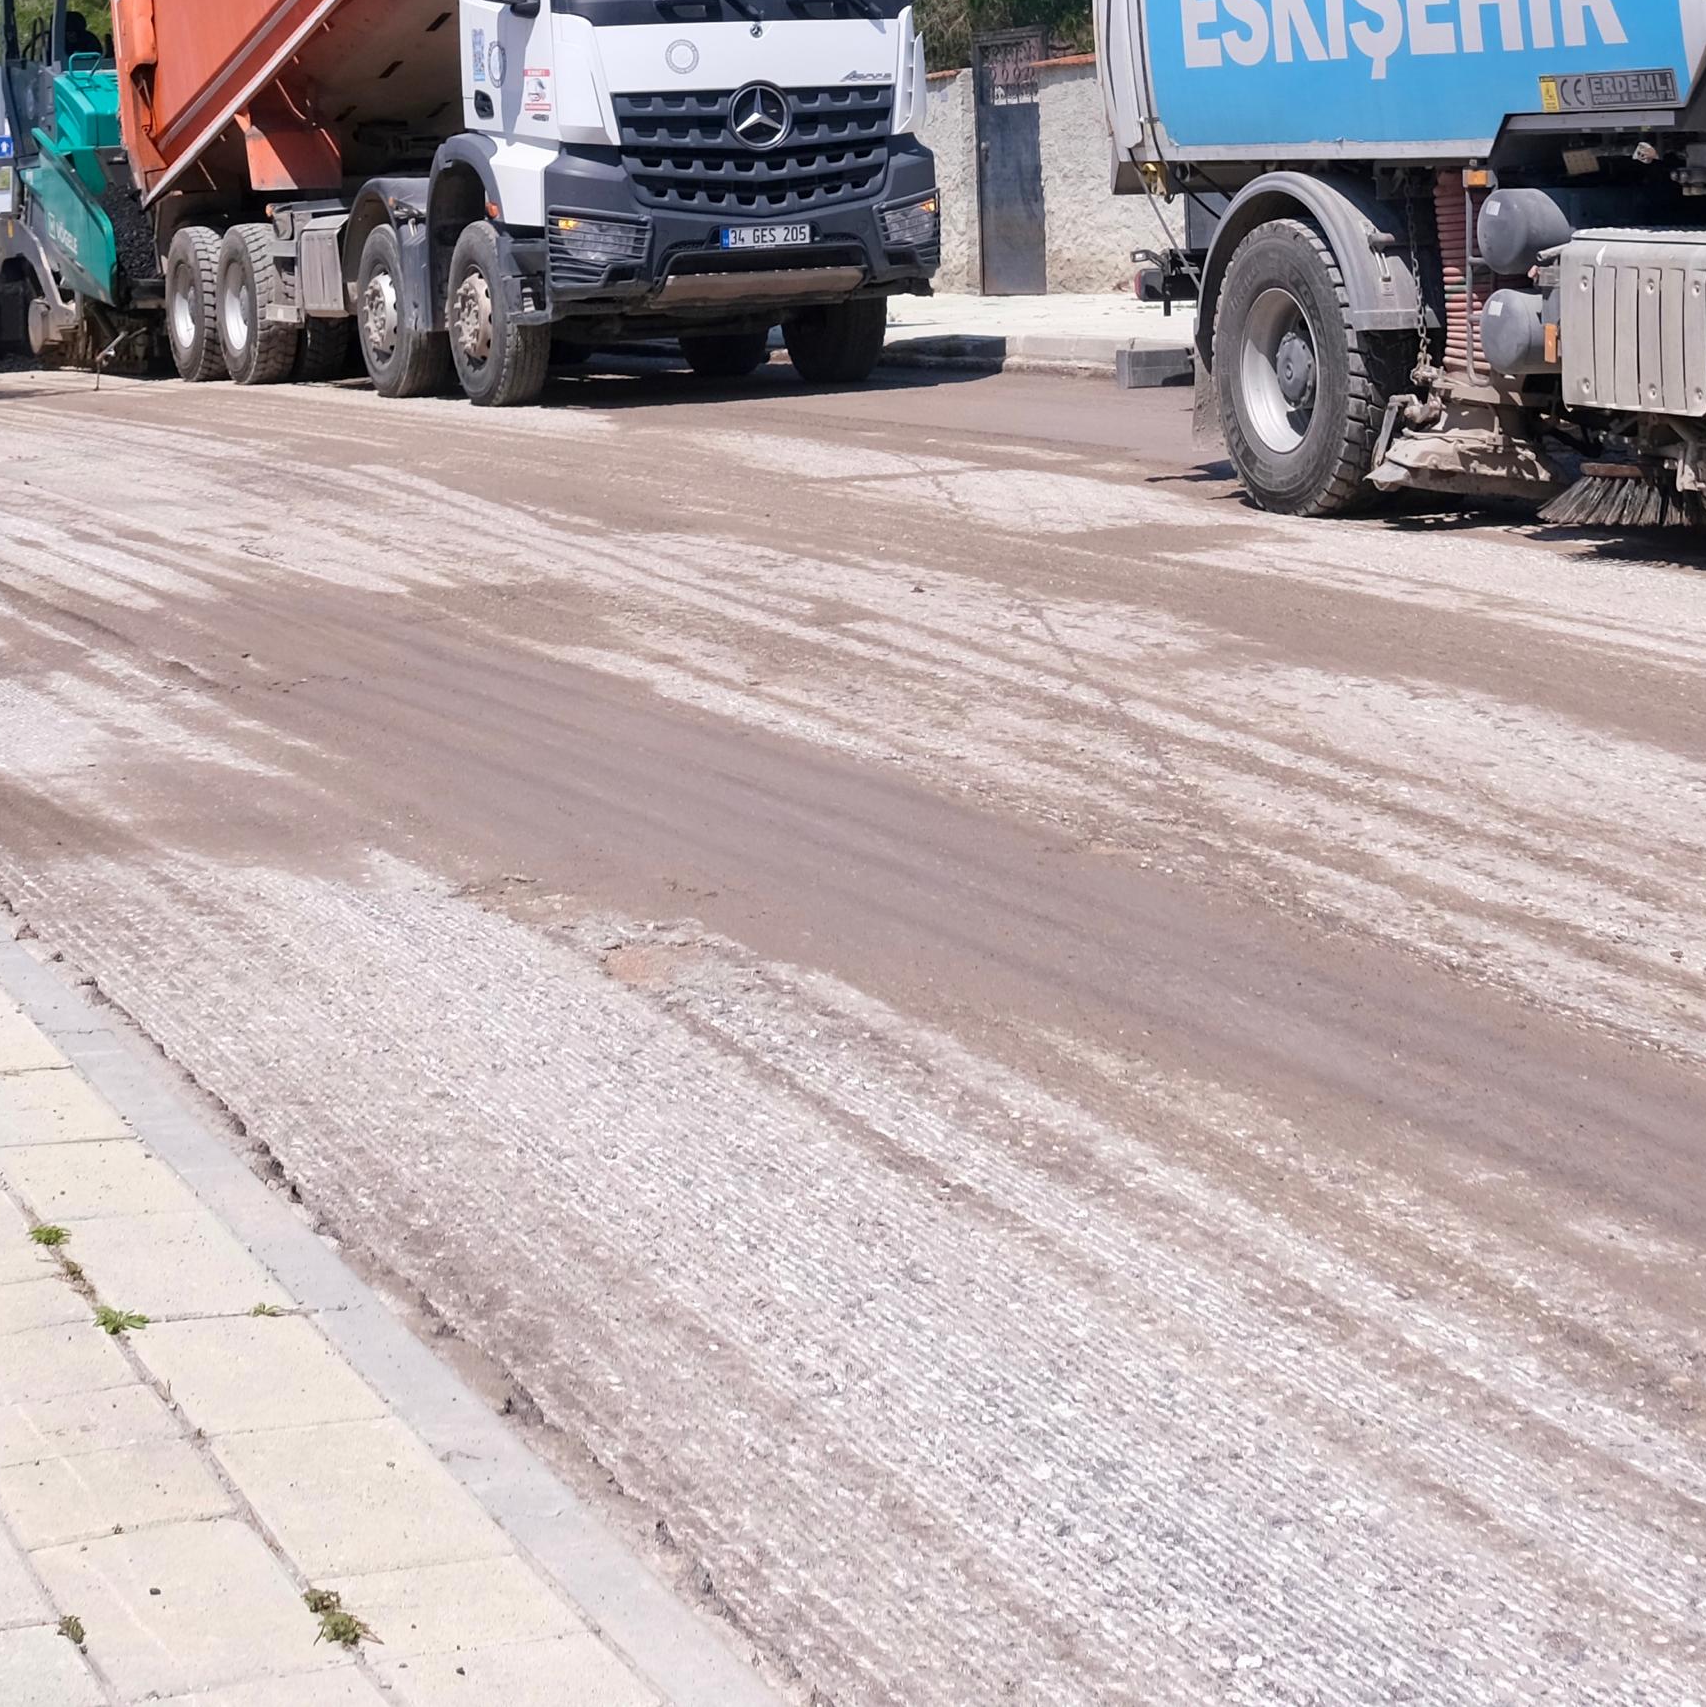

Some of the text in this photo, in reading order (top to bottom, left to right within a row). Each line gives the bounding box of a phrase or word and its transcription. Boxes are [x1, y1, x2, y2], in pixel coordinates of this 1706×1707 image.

[731, 229, 745, 245] 34
[753, 227, 776, 244] GES
[783, 226, 807, 242] 205
